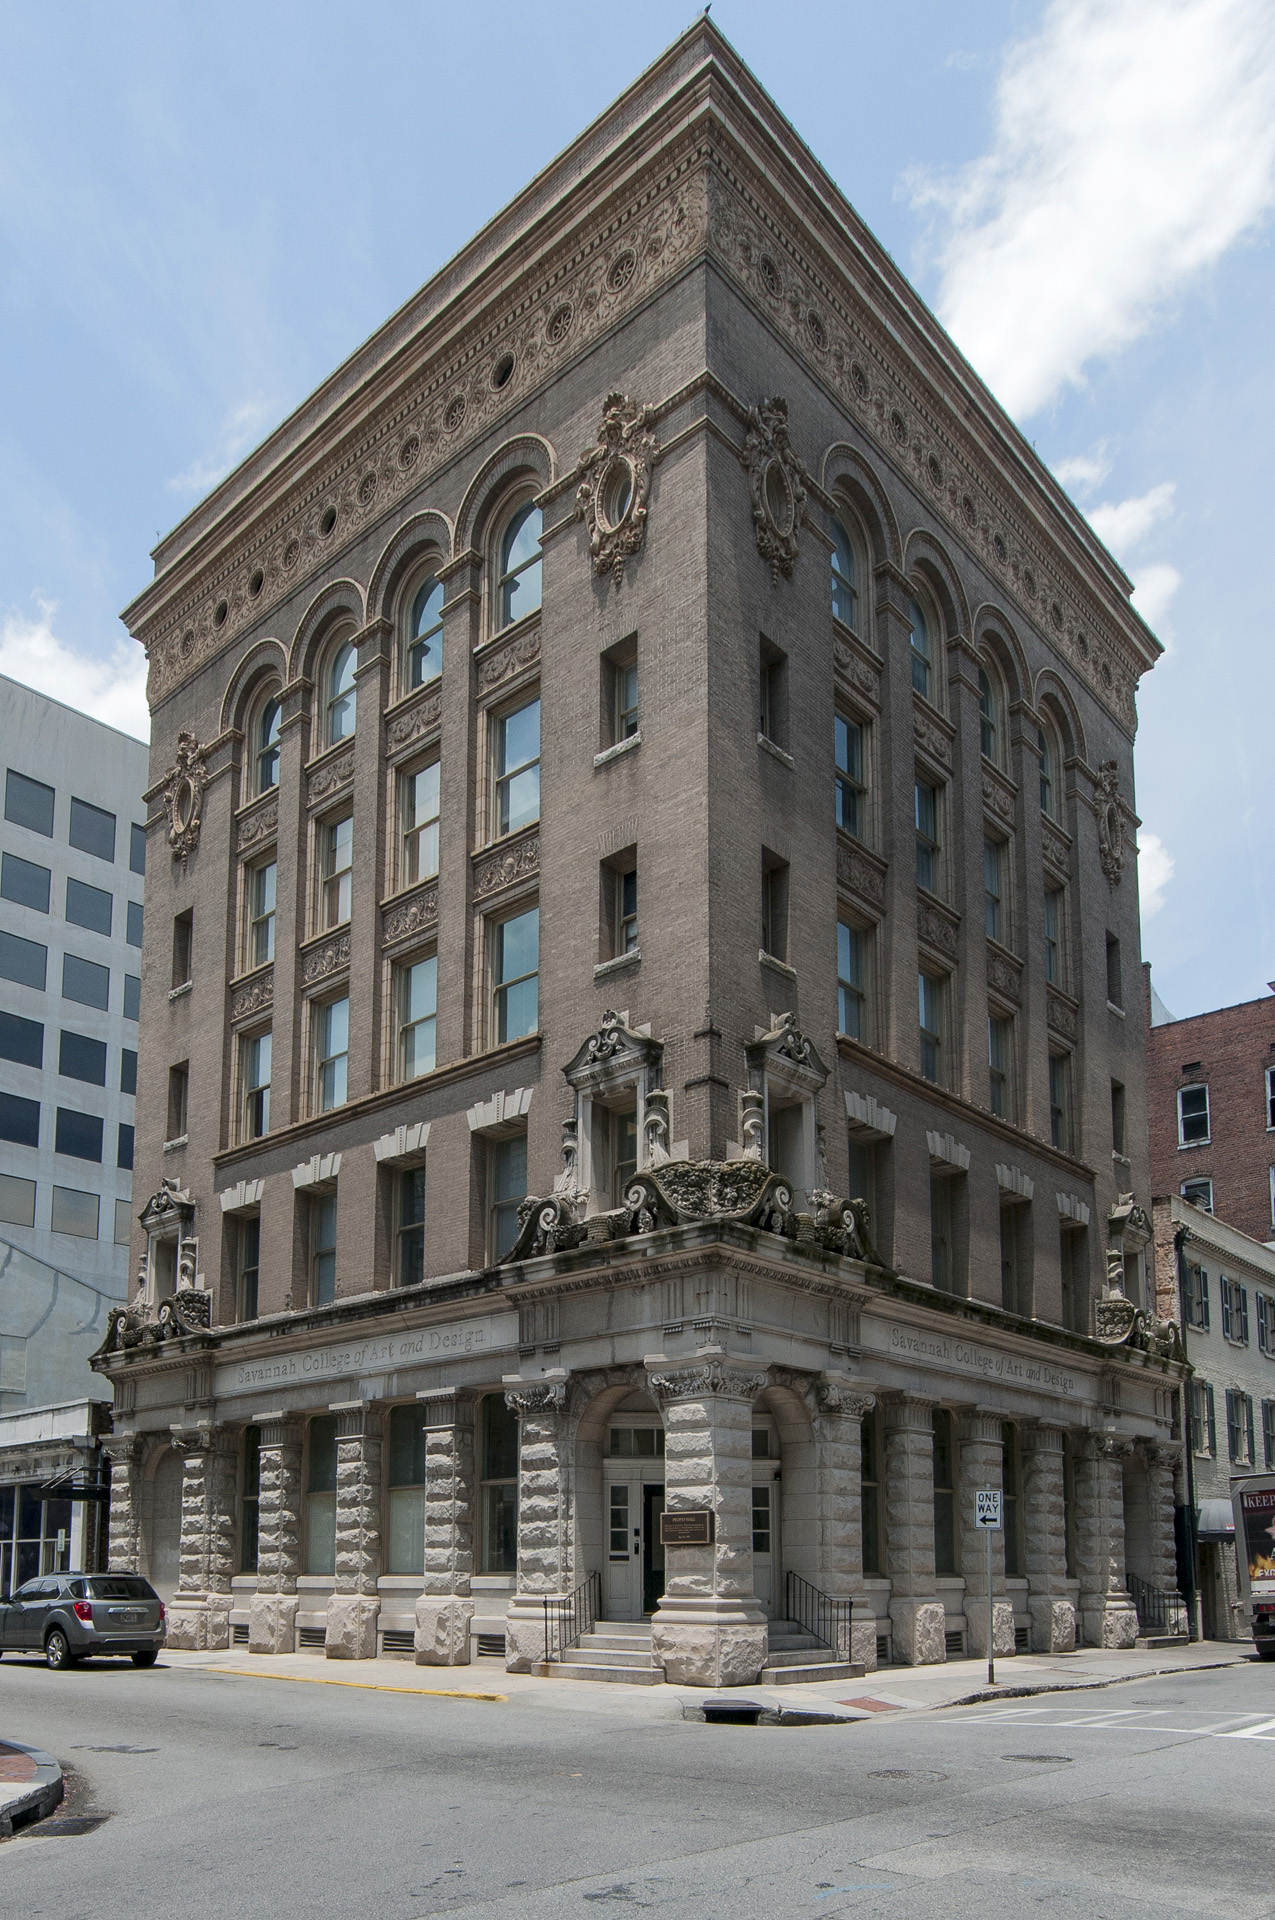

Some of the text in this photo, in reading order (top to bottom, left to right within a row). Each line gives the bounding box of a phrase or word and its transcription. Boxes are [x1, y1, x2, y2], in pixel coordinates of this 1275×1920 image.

[237, 1328, 486, 1383] Savannah College of Art and Design
[891, 1328, 1074, 1394] Savannah College of Art and Design
[978, 1493, 998, 1502] ONE
[1248, 1495, 1275, 1507] KEEP
[978, 1504, 999, 1513] WAY
